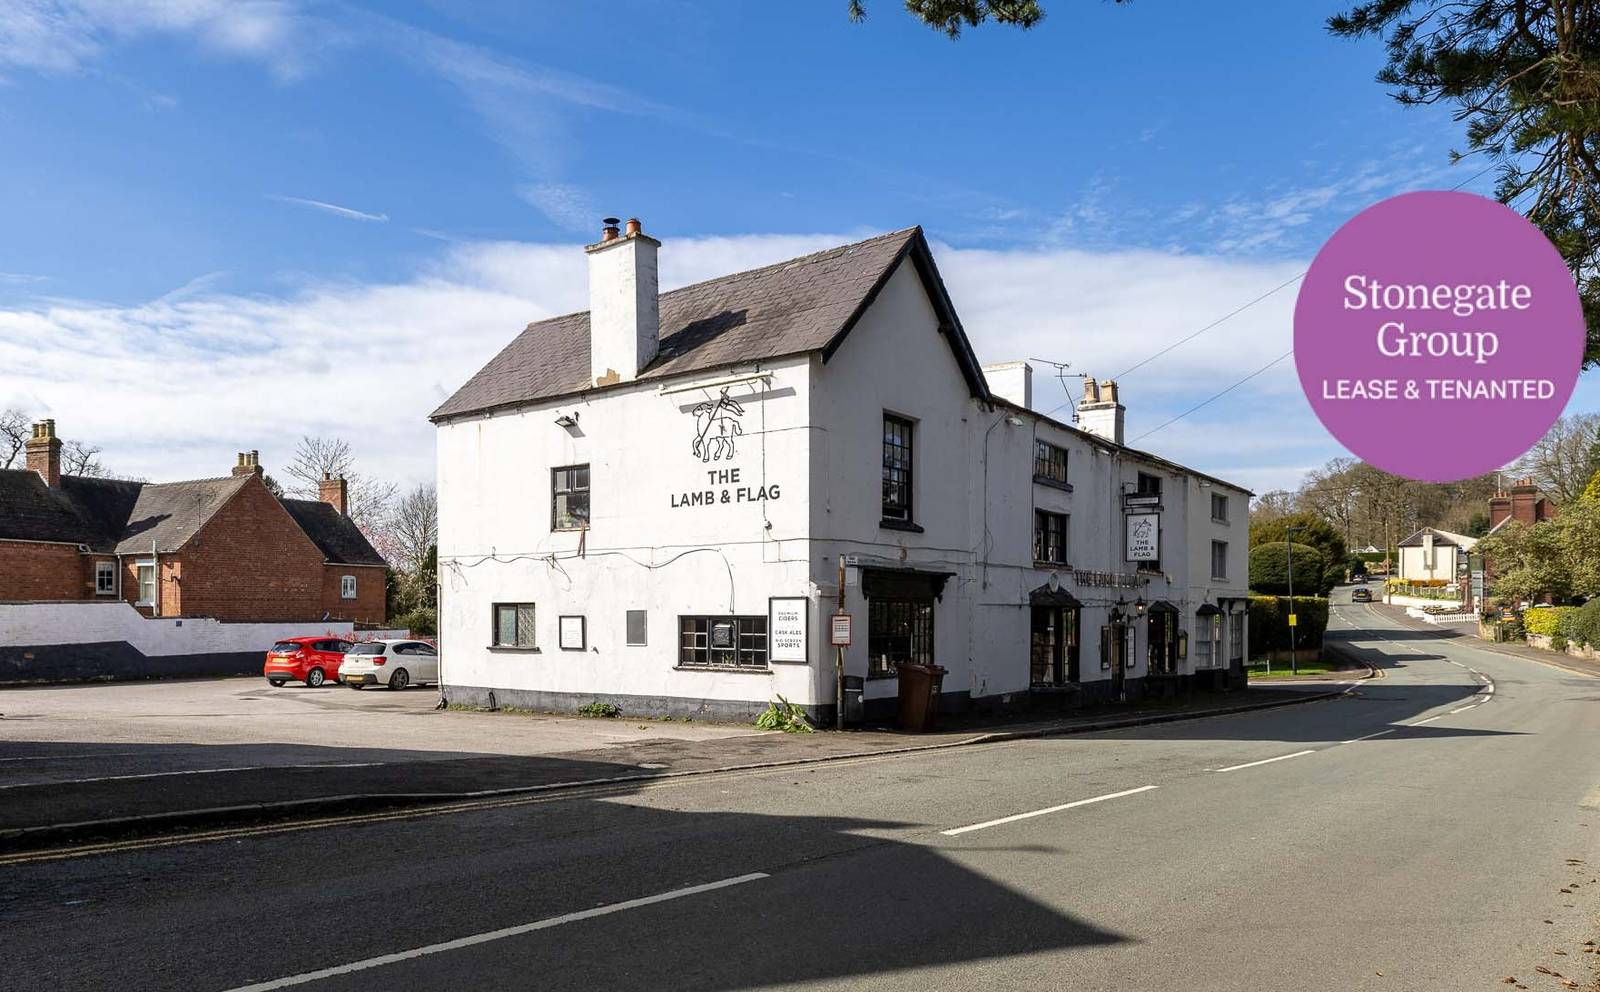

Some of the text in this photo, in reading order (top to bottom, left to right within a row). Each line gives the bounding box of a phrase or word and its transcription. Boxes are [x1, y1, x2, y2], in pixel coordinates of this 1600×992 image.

[708, 468, 740, 485] THE
[671, 484, 781, 508] LAMB & FLAG
